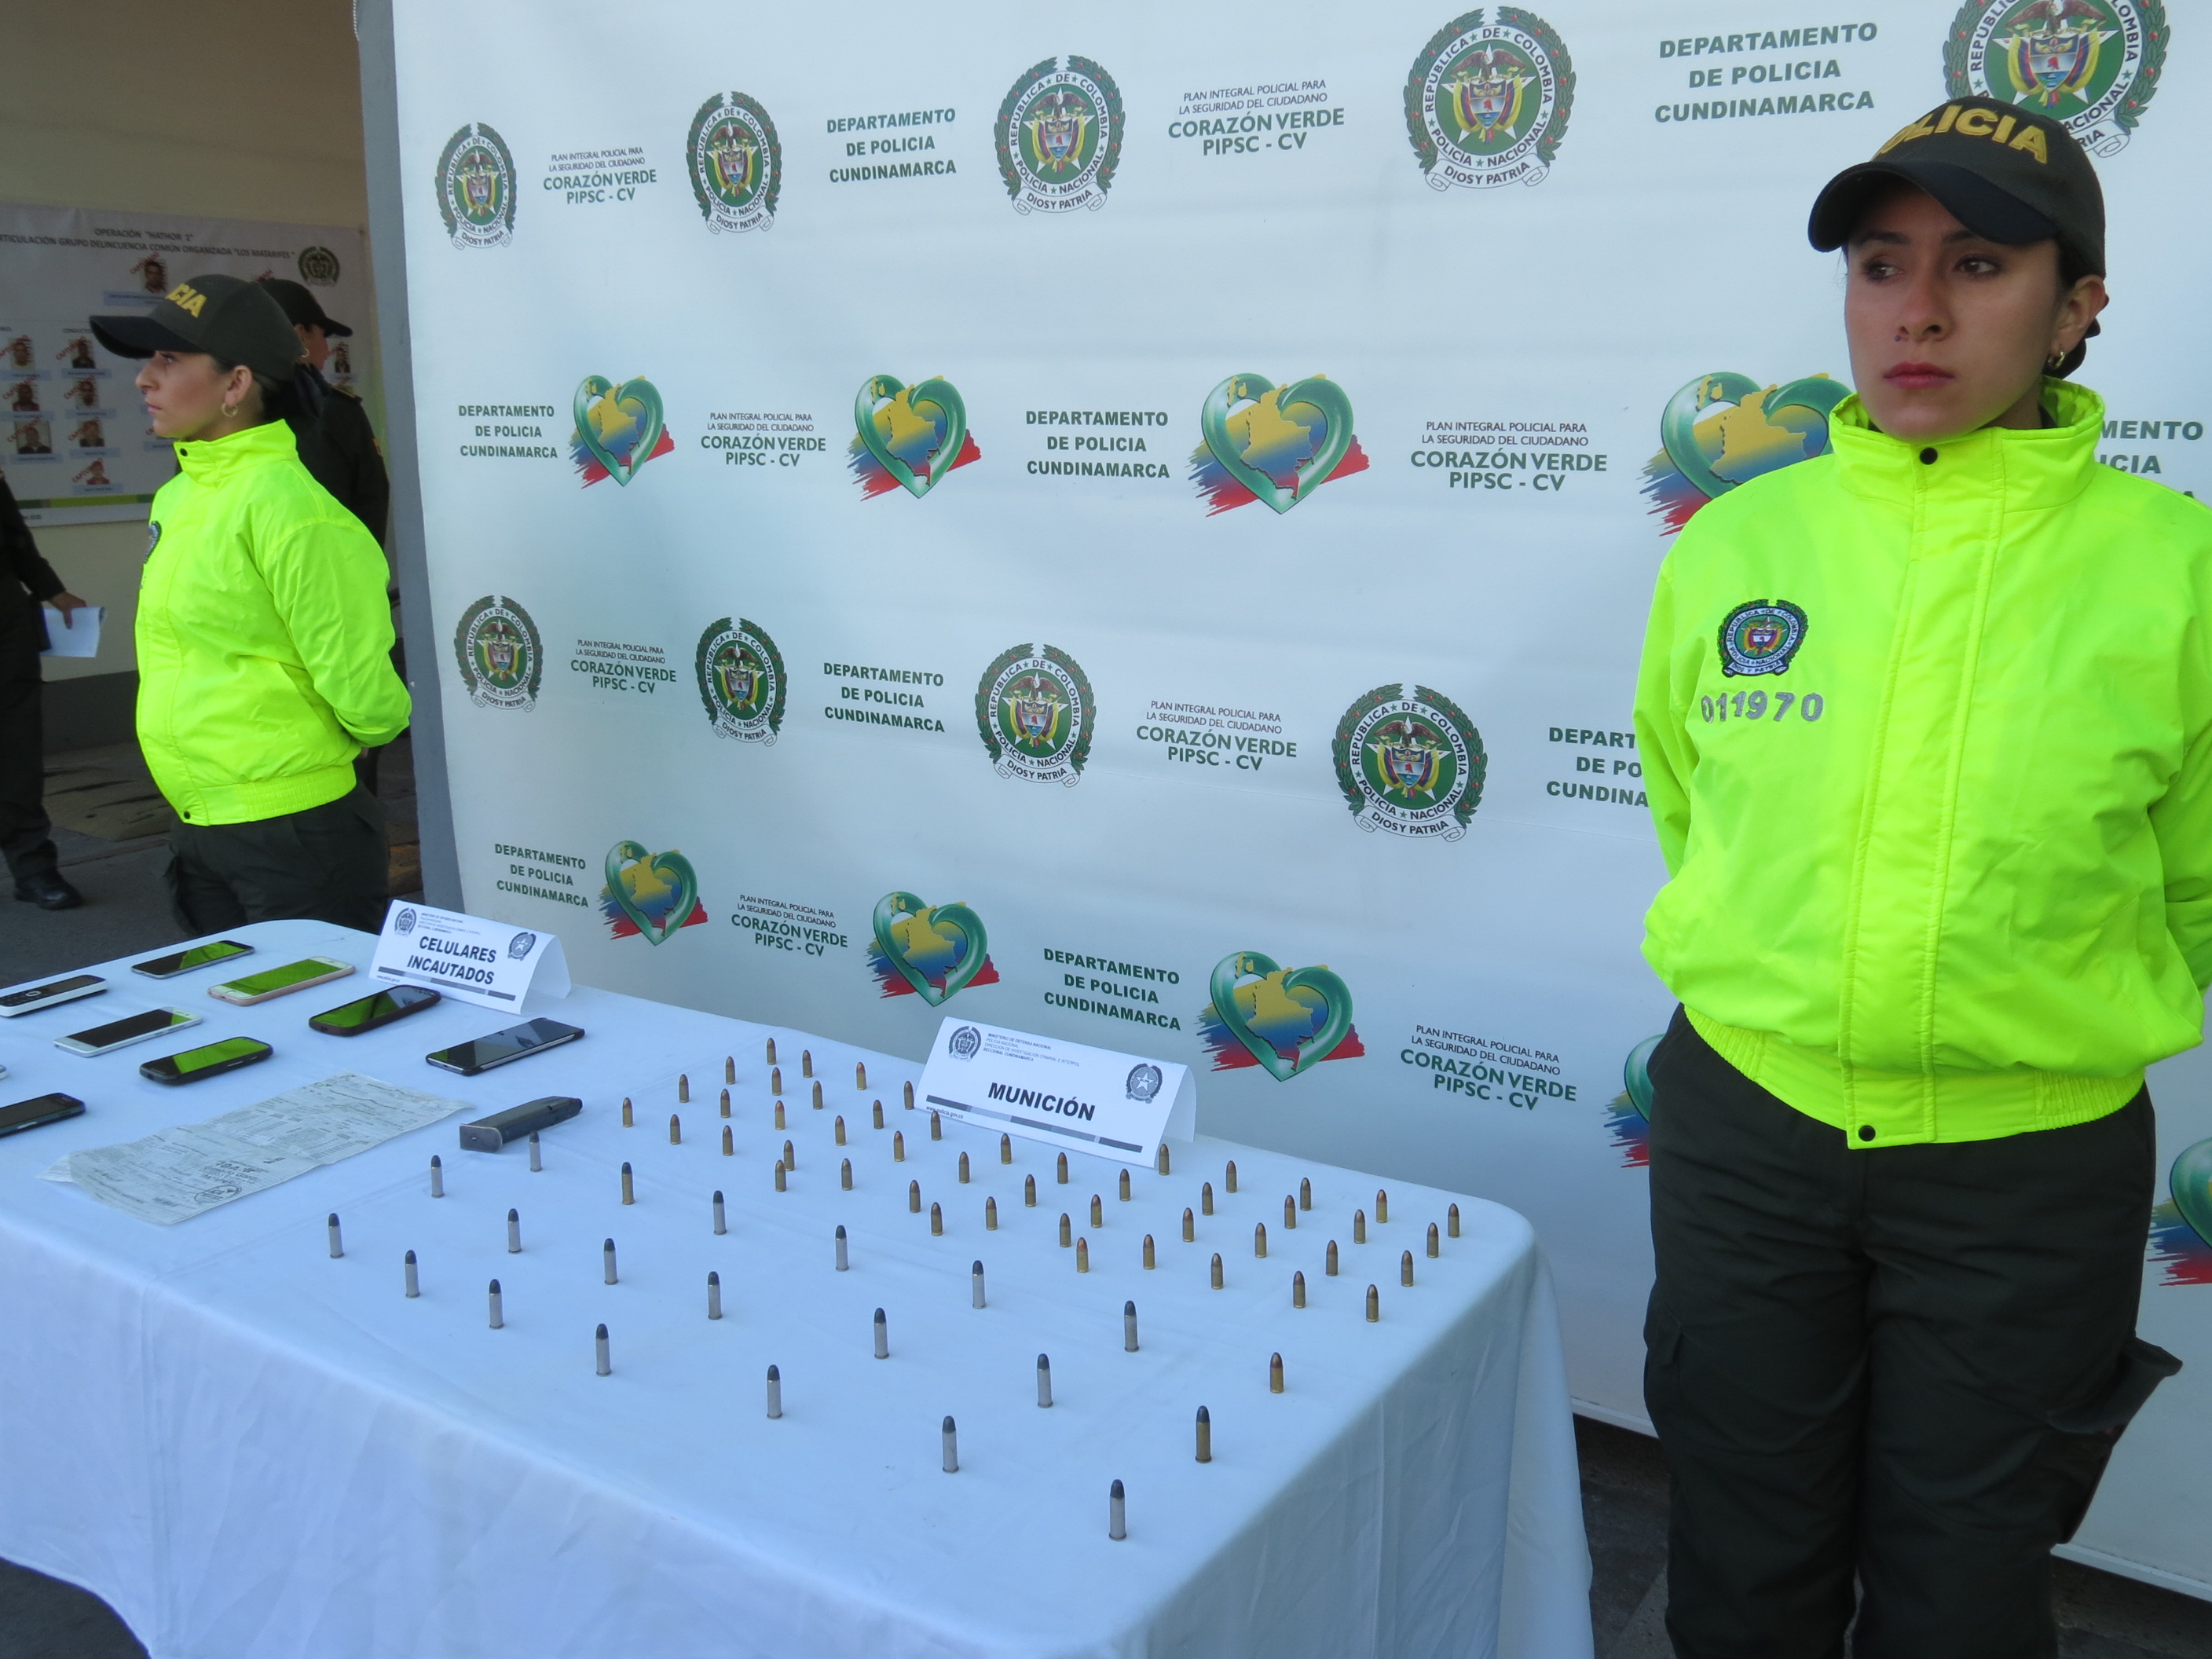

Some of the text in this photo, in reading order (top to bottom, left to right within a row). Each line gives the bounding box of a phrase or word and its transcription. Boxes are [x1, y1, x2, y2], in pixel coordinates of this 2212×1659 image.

[1659, 21, 1877, 59] DEPARTAMENTO
[1482, 27, 1500, 38] DE
[1514, 34, 1553, 104] COLOMBIA
[1689, 58, 1841, 89] DE POLICIA
[1178, 92, 1328, 116] LA SEGURIDAD DEL CIUDADANO
[1183, 79, 1327, 103] PLAN INTEGRAL POLICIAL PARA
[1055, 73, 1070, 83] DE
[1079, 79, 1108, 139] COLOMBIA
[1654, 90, 1875, 123] CUNDINAMARCA
[2064, 82, 2130, 132] ACIONAL
[826, 107, 956, 134] DEPARTAMENTO
[1168, 107, 1345, 139] CORAZÓN VERDE
[846, 134, 936, 157] DE POLICIA
[1203, 134, 1260, 157] PIPSC
[1277, 130, 1308, 152] CV
[1487, 119, 1547, 167] NACIONAL
[543, 168, 657, 192] CORAZÓN VERDE
[829, 159, 957, 184] CUNDINAMARCA
[1059, 153, 1104, 194] NACIONAL
[1486, 161, 1530, 185] PATRIA
[566, 189, 606, 206] PIPSC
[616, 186, 635, 202] CV
[458, 404, 555, 418] DEPARTAMENTO
[1026, 409, 1169, 427] DEPARTAMENTO
[474, 424, 543, 438] DE POLICIA
[1426, 420, 1588, 434] PLAN INTEGRAL POLICIAL PARA
[460, 445, 558, 459] CUNDINAMARCA
[701, 432, 826, 452] CORAZÓN VERDE
[1047, 435, 1147, 452] DE POLICIA
[1422, 434, 1589, 447] LA SEGURIDAD DEL CIUDADANO
[726, 451, 767, 467] PIPSC
[778, 452, 800, 467] CV
[1027, 460, 1170, 479] CUNDINAMARCA
[1410, 447, 1607, 473] CORAZÓN VERDE
[1449, 471, 1513, 490] PIPSC
[1533, 473, 1566, 493] CV
[570, 658, 677, 683] CORAZÓN VERDE
[823, 661, 944, 687] DEPARTAMENTO
[592, 675, 628, 692] PIPSC
[637, 680, 656, 694] CV
[840, 685, 925, 709] DE POLICIA
[824, 705, 945, 734] CUNDINAMARCA
[1151, 699, 1281, 723] PLAN INTEGRAL POLICIAL PARA
[1701, 690, 1824, 723] 011970
[1146, 711, 1283, 735] LA SEGURIDAD DEL CIUDADANO
[1136, 724, 1297, 759] CORAZÓN VERDE
[1401, 701, 1419, 712] DE
[1430, 712, 1467, 776] COLOMBIA
[1549, 727, 1635, 750] DEPART
[1168, 745, 1220, 767] PIPSC
[1236, 753, 1263, 771] CV
[1576, 756, 1606, 775] DE
[1409, 786, 1463, 820] NACIONAL
[1546, 780, 1649, 808] CUNDINA
[1409, 820, 1449, 835] PATRIA
[494, 842, 586, 870] DEPARTAMENTO
[510, 863, 574, 887] DE POLICIA
[496, 879, 589, 908] CUNDINAMARCA
[731, 913, 848, 949] CORAZÓN VERDE
[419, 936, 497, 963] CELULARES
[755, 932, 793, 952] PIPSC
[804, 942, 825, 958] CV
[406, 954, 495, 985] INCAUTADOS
[1043, 947, 1180, 986] DEPARTAMENTO
[1064, 972, 1159, 1005] DE POLICIA
[1044, 991, 1181, 1031] CUNDINAMARCA
[1411, 1035, 1561, 1076] LA SEGURIDAD DEL CIUDADANO
[1415, 1024, 1560, 1064] PLAN INTEGRAL POLICIAL PARA
[1400, 1048, 1577, 1102] CORAZÓN VERDE
[987, 1082, 1096, 1122] MUNICIÓN
[1434, 1072, 1491, 1101] PIPSC
[1508, 1091, 1539, 1111] CV
